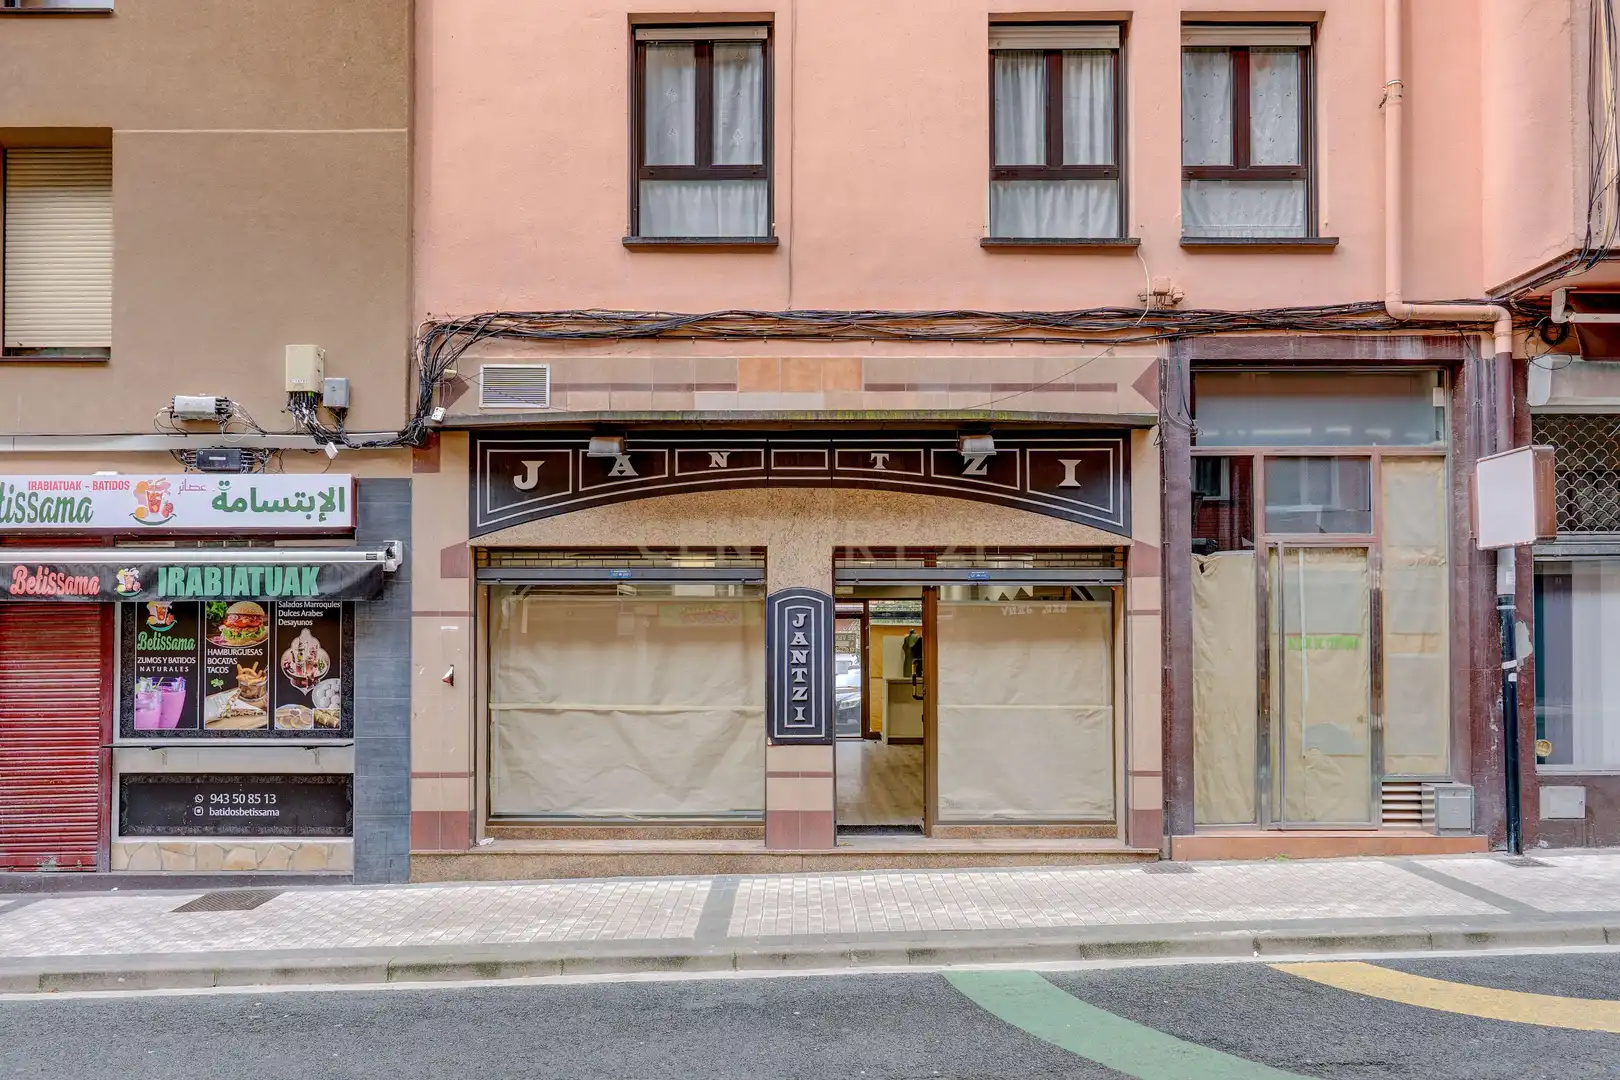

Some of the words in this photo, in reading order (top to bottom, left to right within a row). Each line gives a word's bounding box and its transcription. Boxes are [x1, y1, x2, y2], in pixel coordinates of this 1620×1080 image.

[28, 480, 81, 491] IRABIATUAK
[92, 480, 130, 491] BATIDOS
[178, 478, 207, 495] عصائر
[10, 565, 100, 595] Betissama
[158, 567, 320, 597] IRABIATUAK
[278, 600, 303, 608] Salados
[278, 619, 313, 627] Desayunos
[137, 631, 196, 651] Betissama
[207, 648, 263, 656] HAMBURGUESAS
[137, 656, 162, 664] ZUMOS
[162, 656, 168, 664] Y
[168, 656, 196, 664] BATIDOS
[207, 657, 238, 665] BOCATAS
[207, 666, 229, 674] TACOS
[790, 613, 810, 722] JANTZI
[210, 793, 230, 804] 943
[232, 793, 246, 804] 50
[247, 793, 261, 804] 85
[264, 793, 277, 804] 13
[209, 806, 280, 817] batidosbetissama
